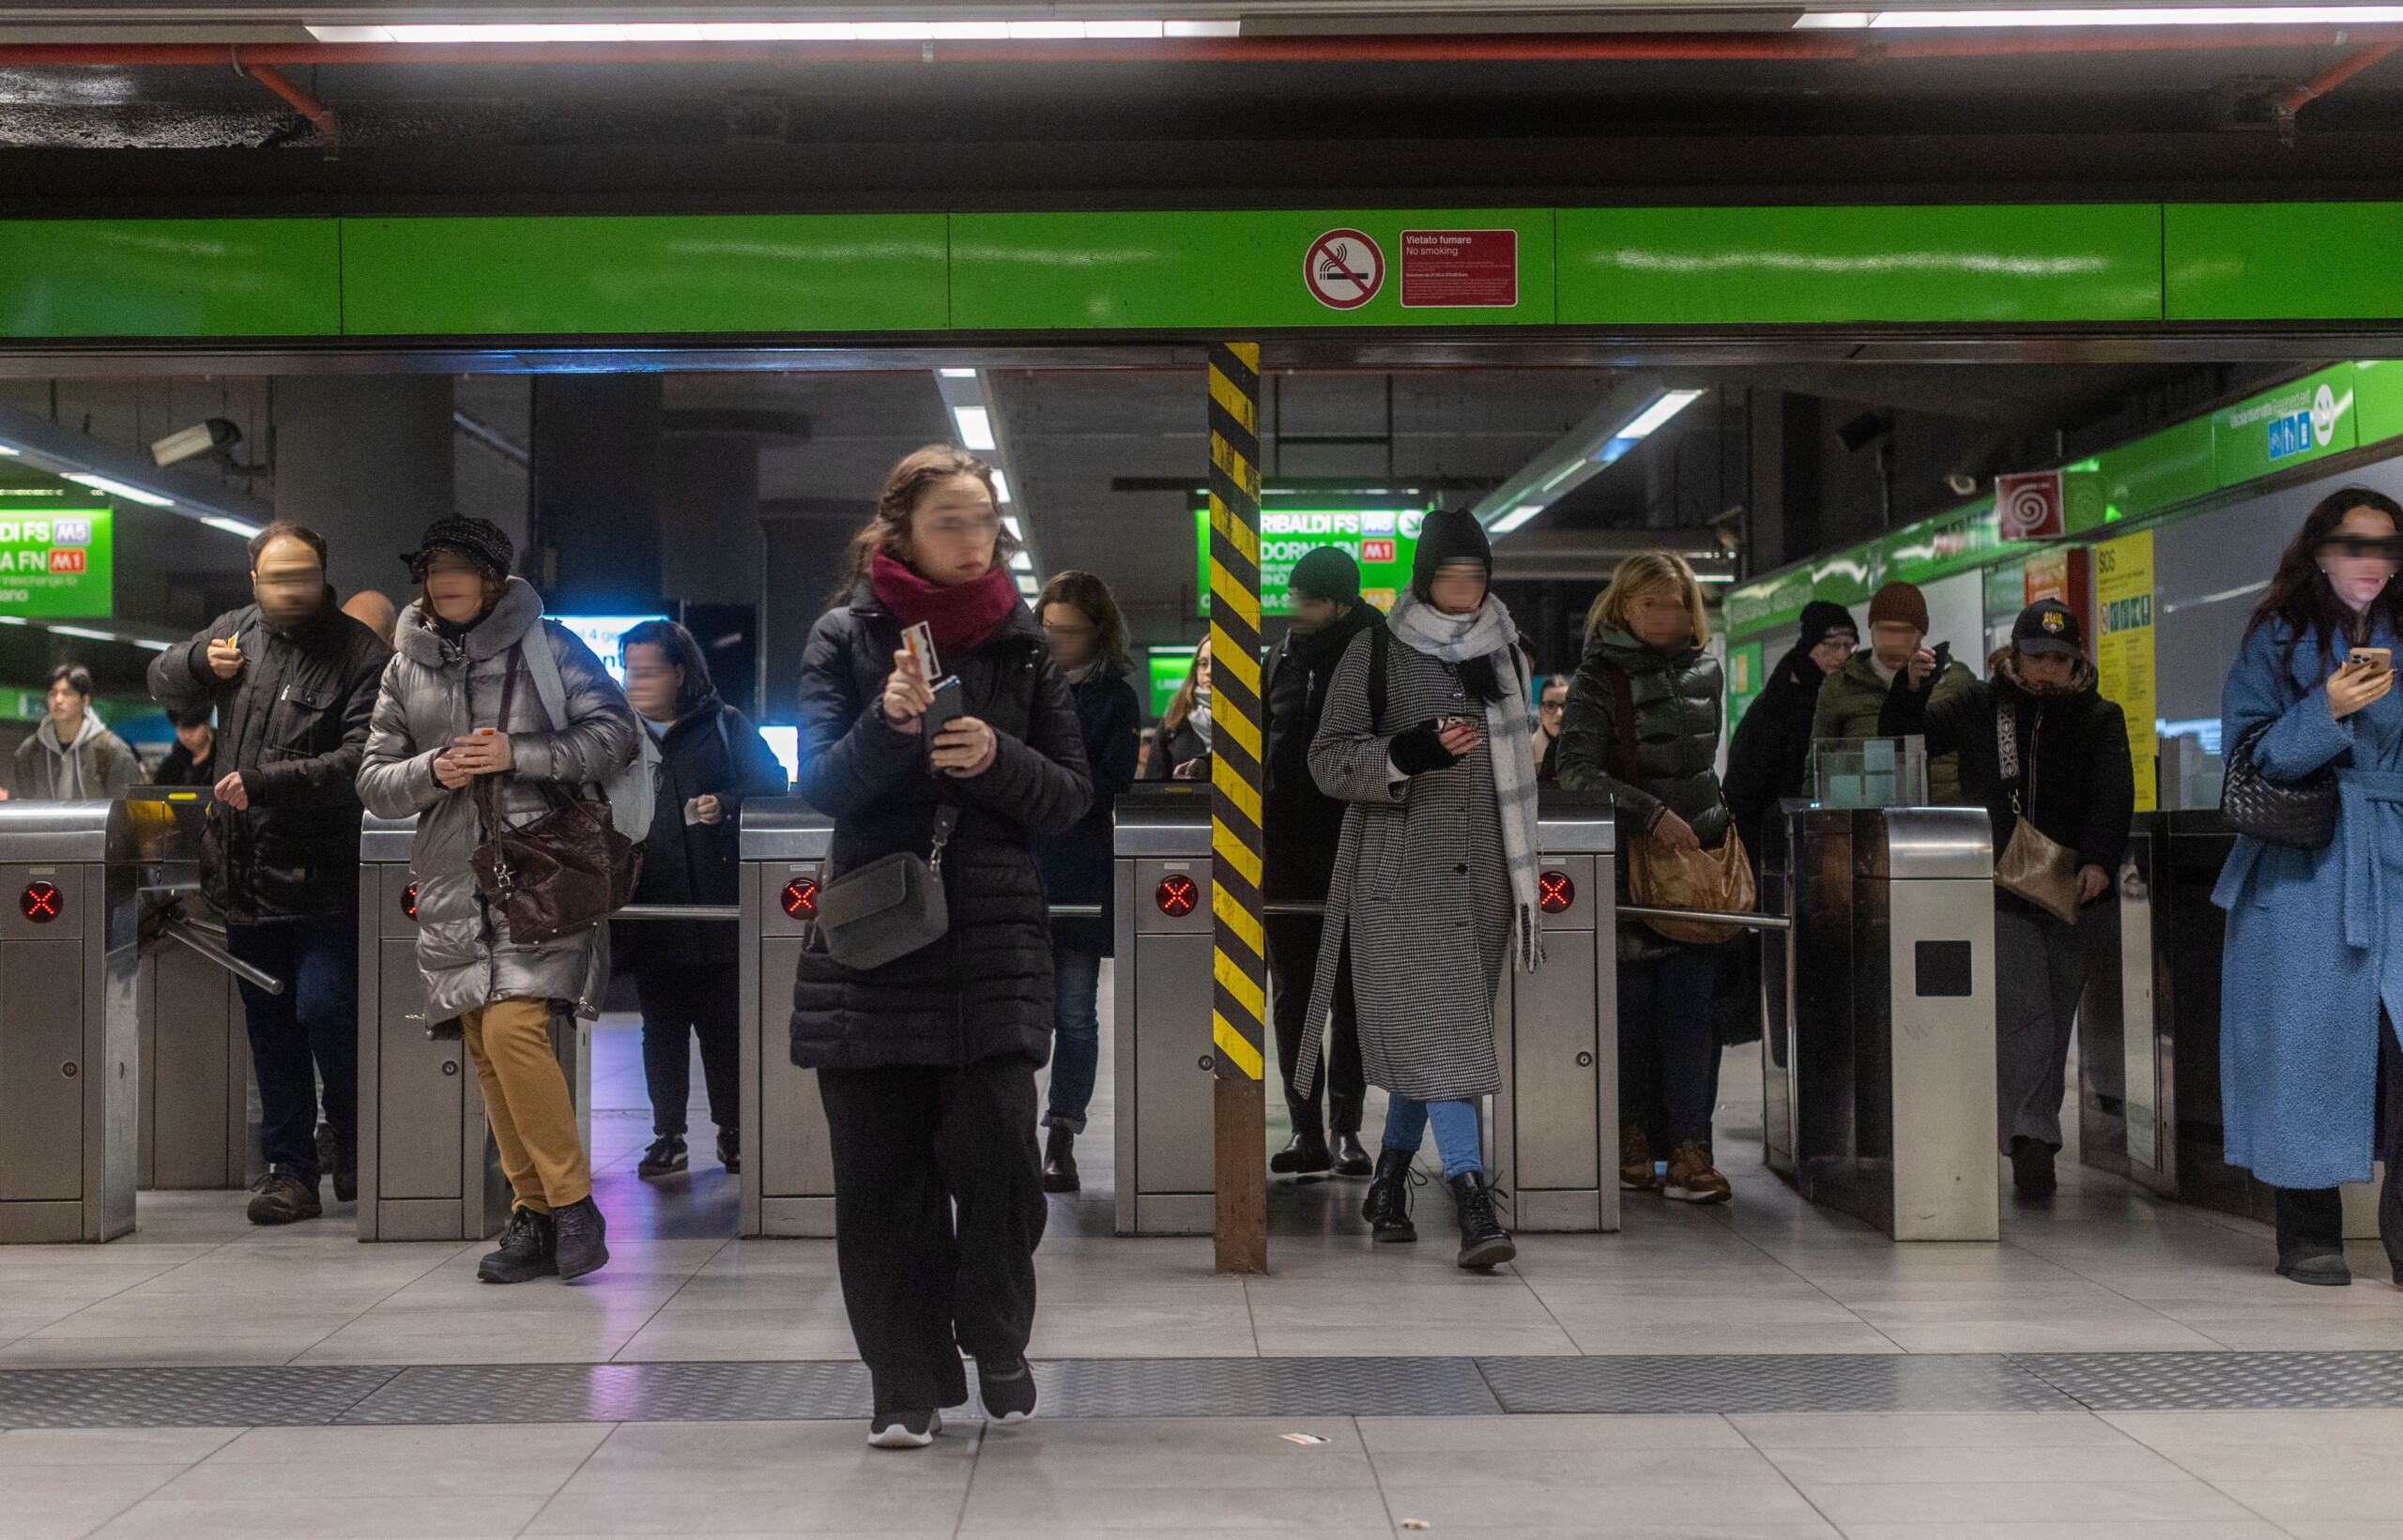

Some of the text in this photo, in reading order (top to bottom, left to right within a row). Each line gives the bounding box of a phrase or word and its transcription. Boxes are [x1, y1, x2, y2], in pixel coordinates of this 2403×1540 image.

[1406, 236, 1472, 245] Vietato fumare
[1406, 246, 1459, 257] No smoking
[23, 521, 50, 542] FS
[56, 524, 86, 541] M5
[1334, 514, 1359, 534] FS
[1364, 543, 1391, 559] M1
[2099, 549, 2115, 573] SOS
[0, 551, 81, 572] A FN M1
